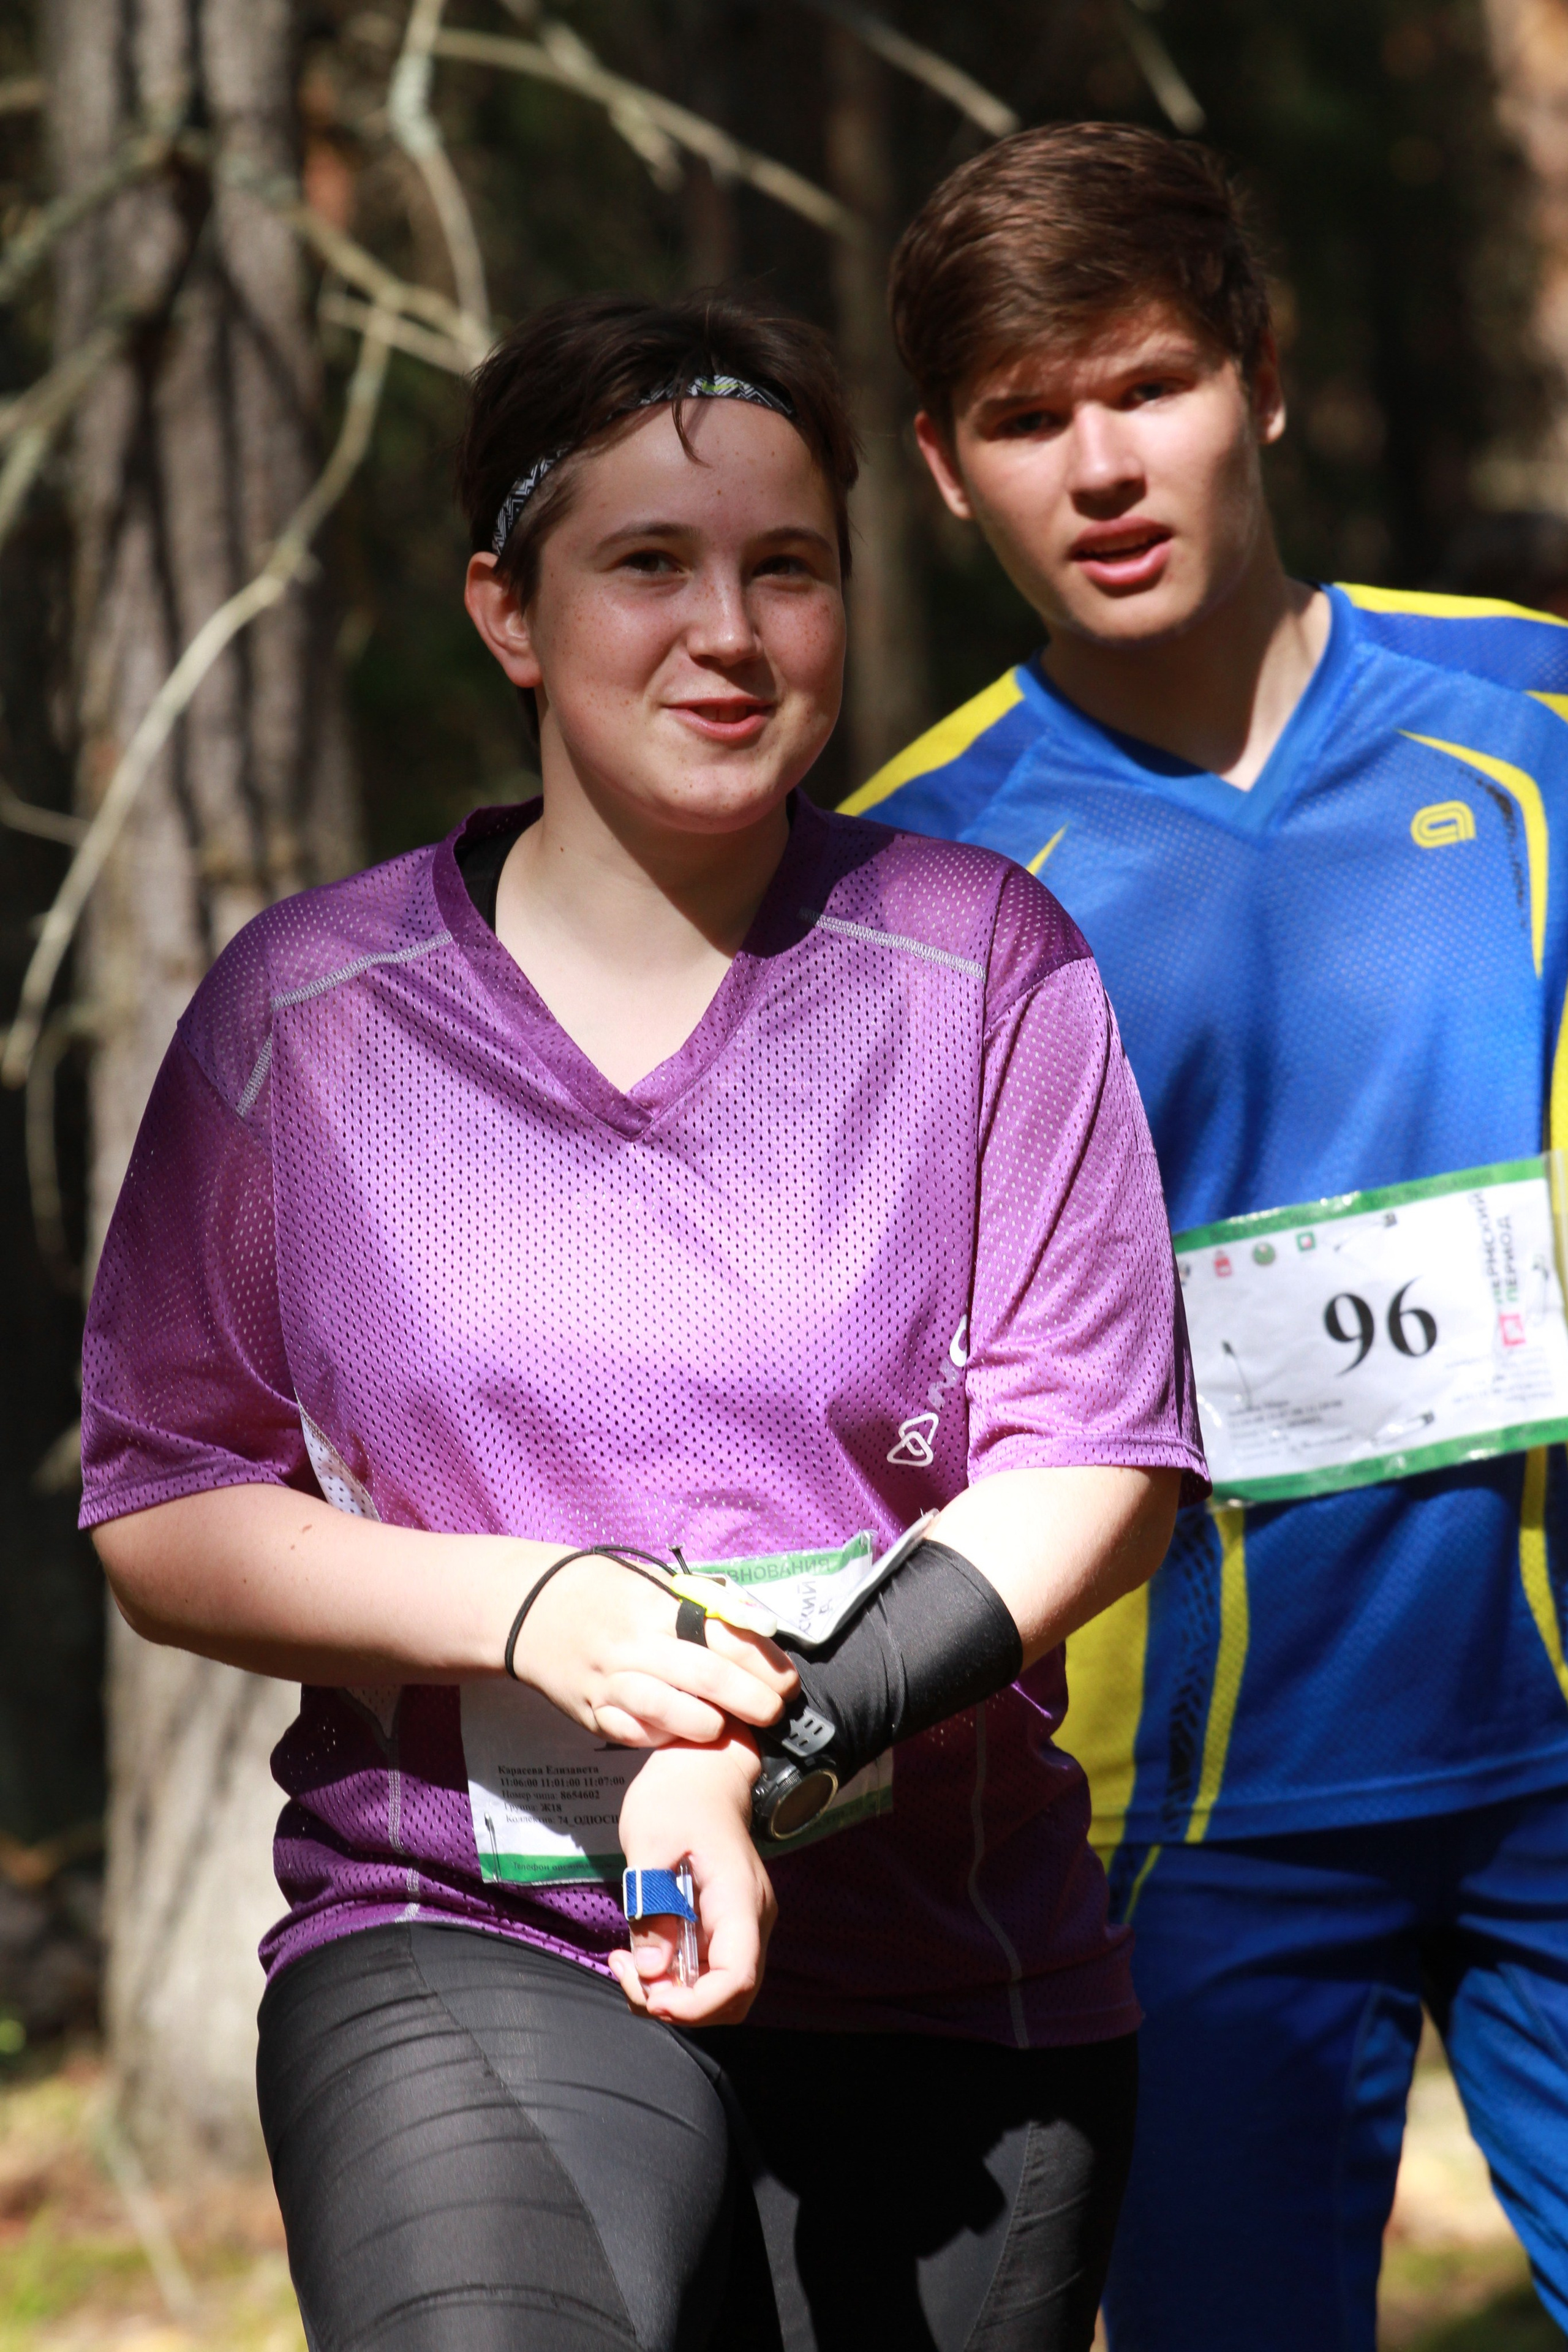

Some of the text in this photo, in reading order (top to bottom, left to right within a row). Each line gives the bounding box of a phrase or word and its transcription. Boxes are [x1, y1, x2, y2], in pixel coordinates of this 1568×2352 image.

[1322, 1274, 1438, 1377] 96
[710, 1558, 831, 1583] ВНОВАНИЯ
[498, 1765, 599, 1776] Карасева Елизавета
[500, 1776, 625, 1787] 11:06:00 11:01:00 11:07:00
[560, 1790, 600, 1800] 8654602
[540, 1803, 562, 1813] Ж18
